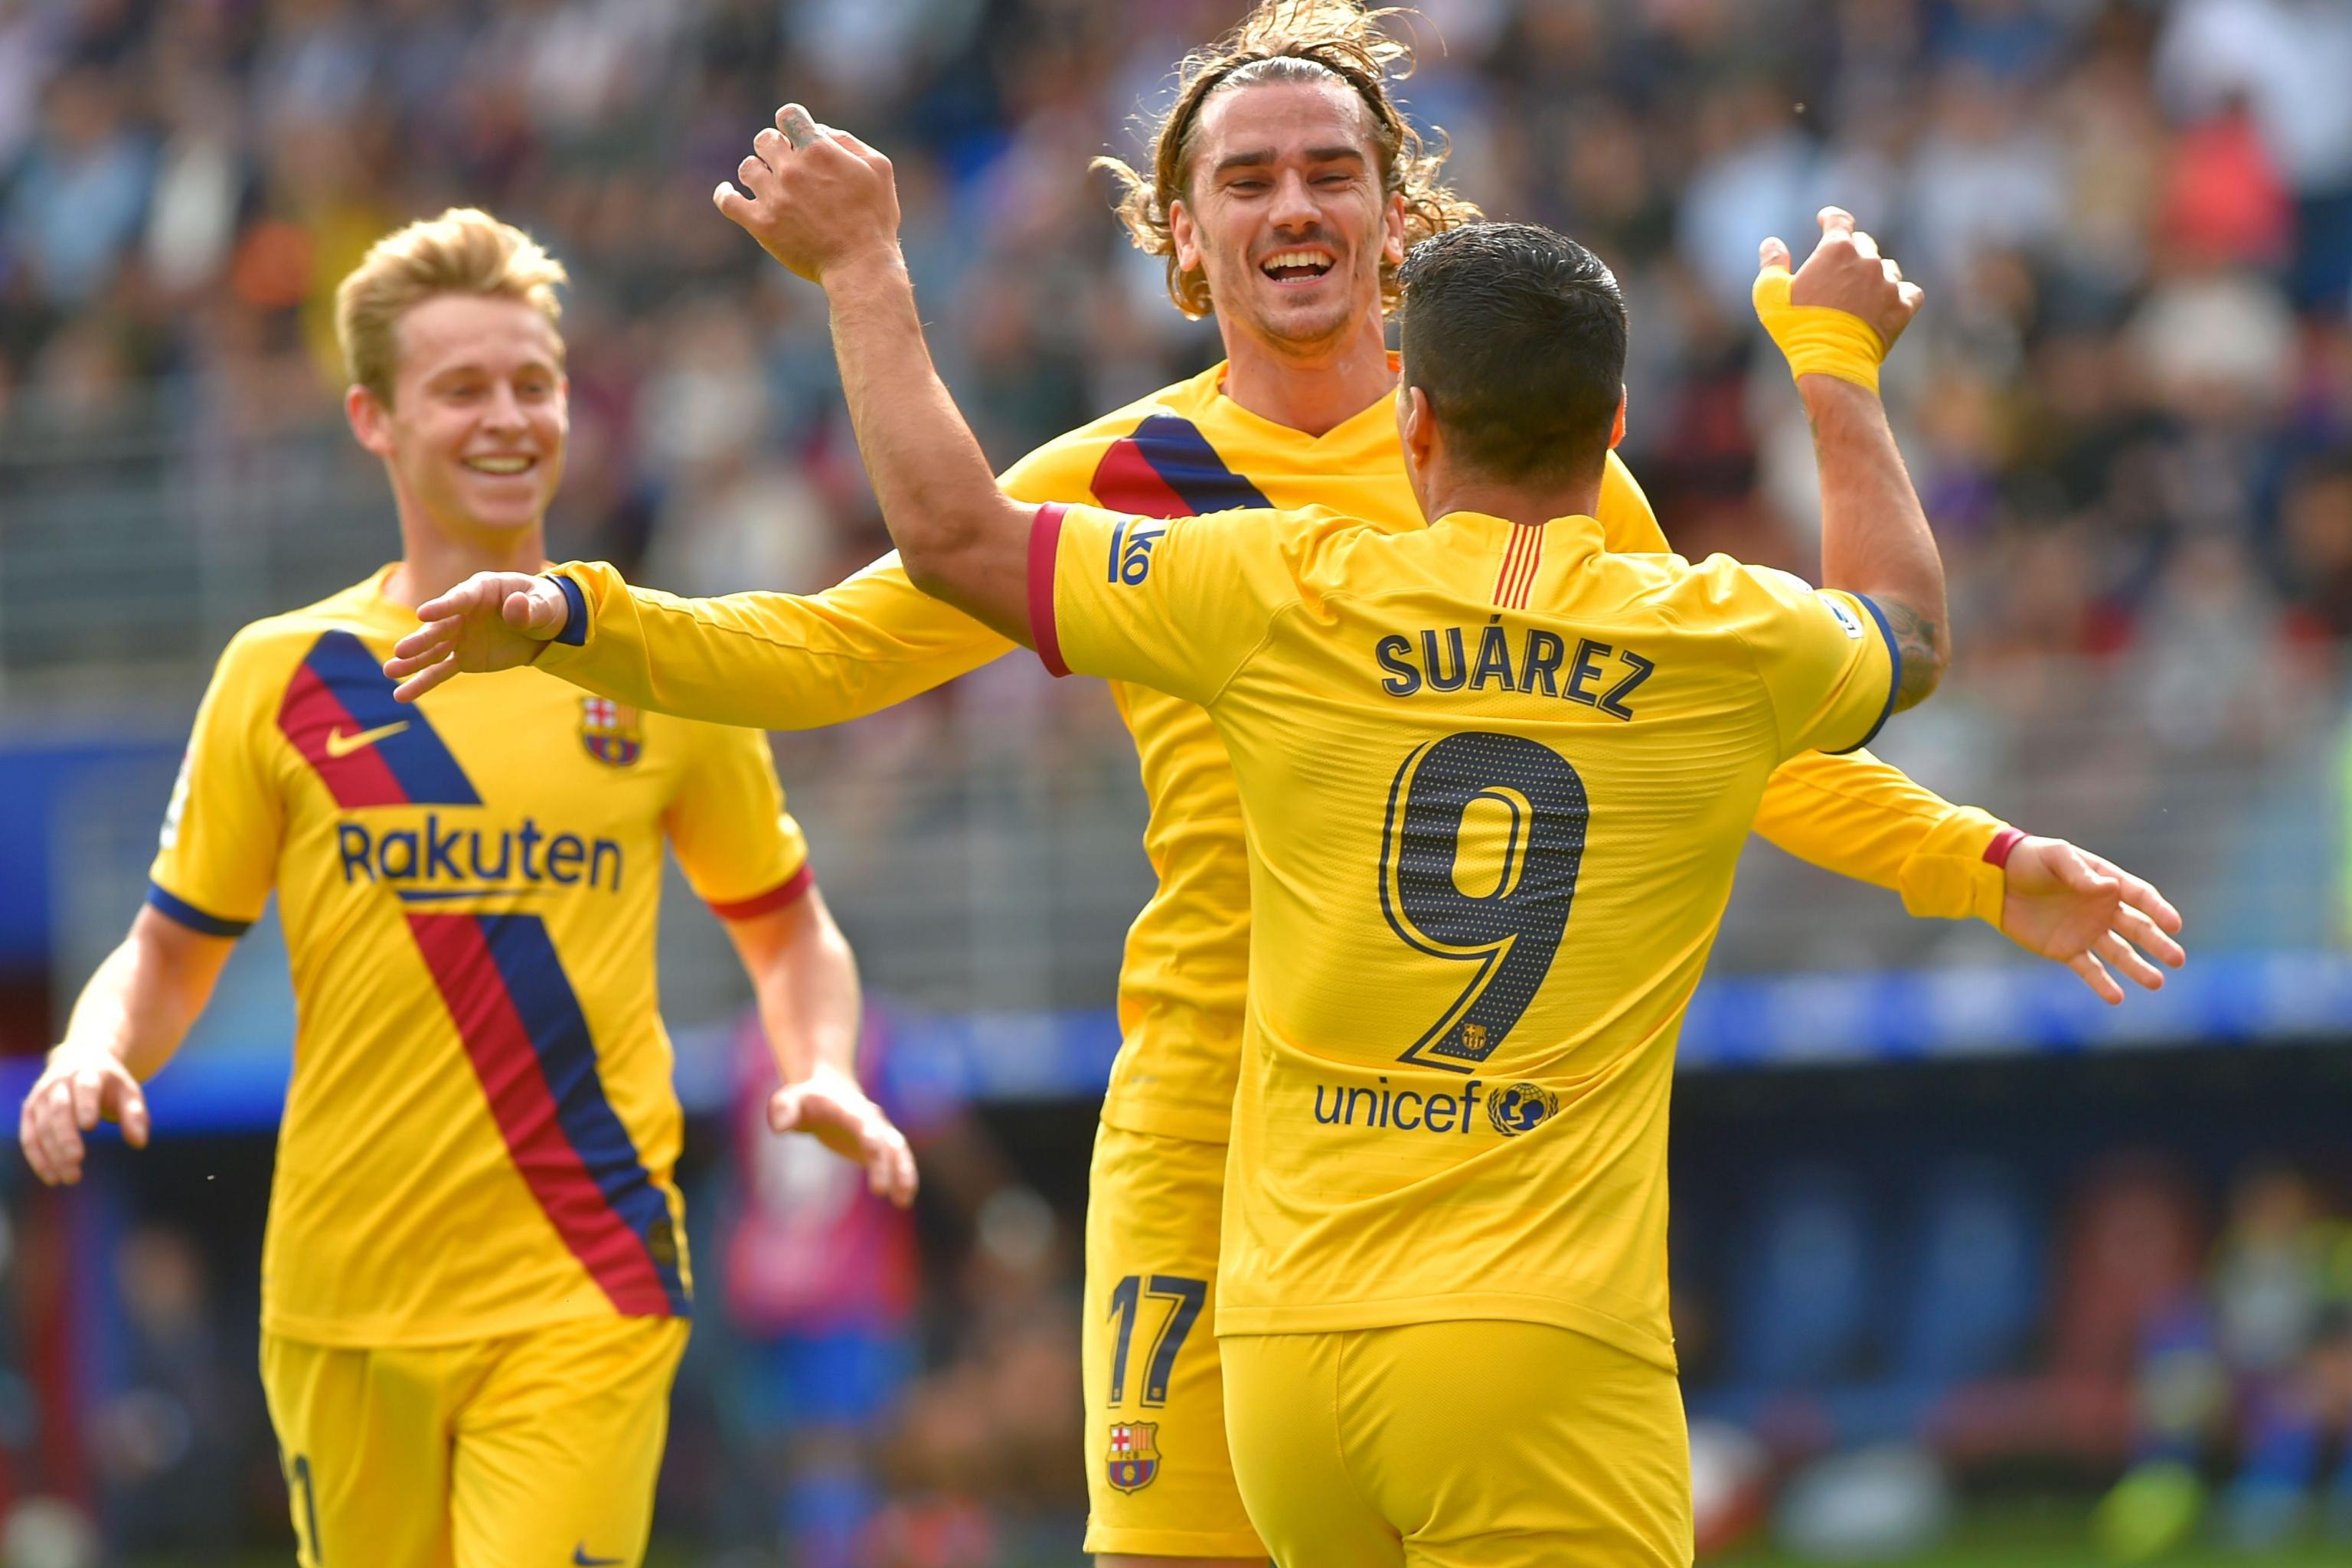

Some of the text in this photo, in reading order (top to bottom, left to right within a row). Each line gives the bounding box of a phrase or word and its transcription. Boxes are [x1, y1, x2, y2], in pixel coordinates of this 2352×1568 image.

[1375, 614, 1655, 722] SUÁREZ
[338, 814, 622, 893] Rakuten
[1379, 731, 1589, 1074] 9
[1314, 1077, 1482, 1134] unicef
[1107, 1274, 1207, 1409] 17
